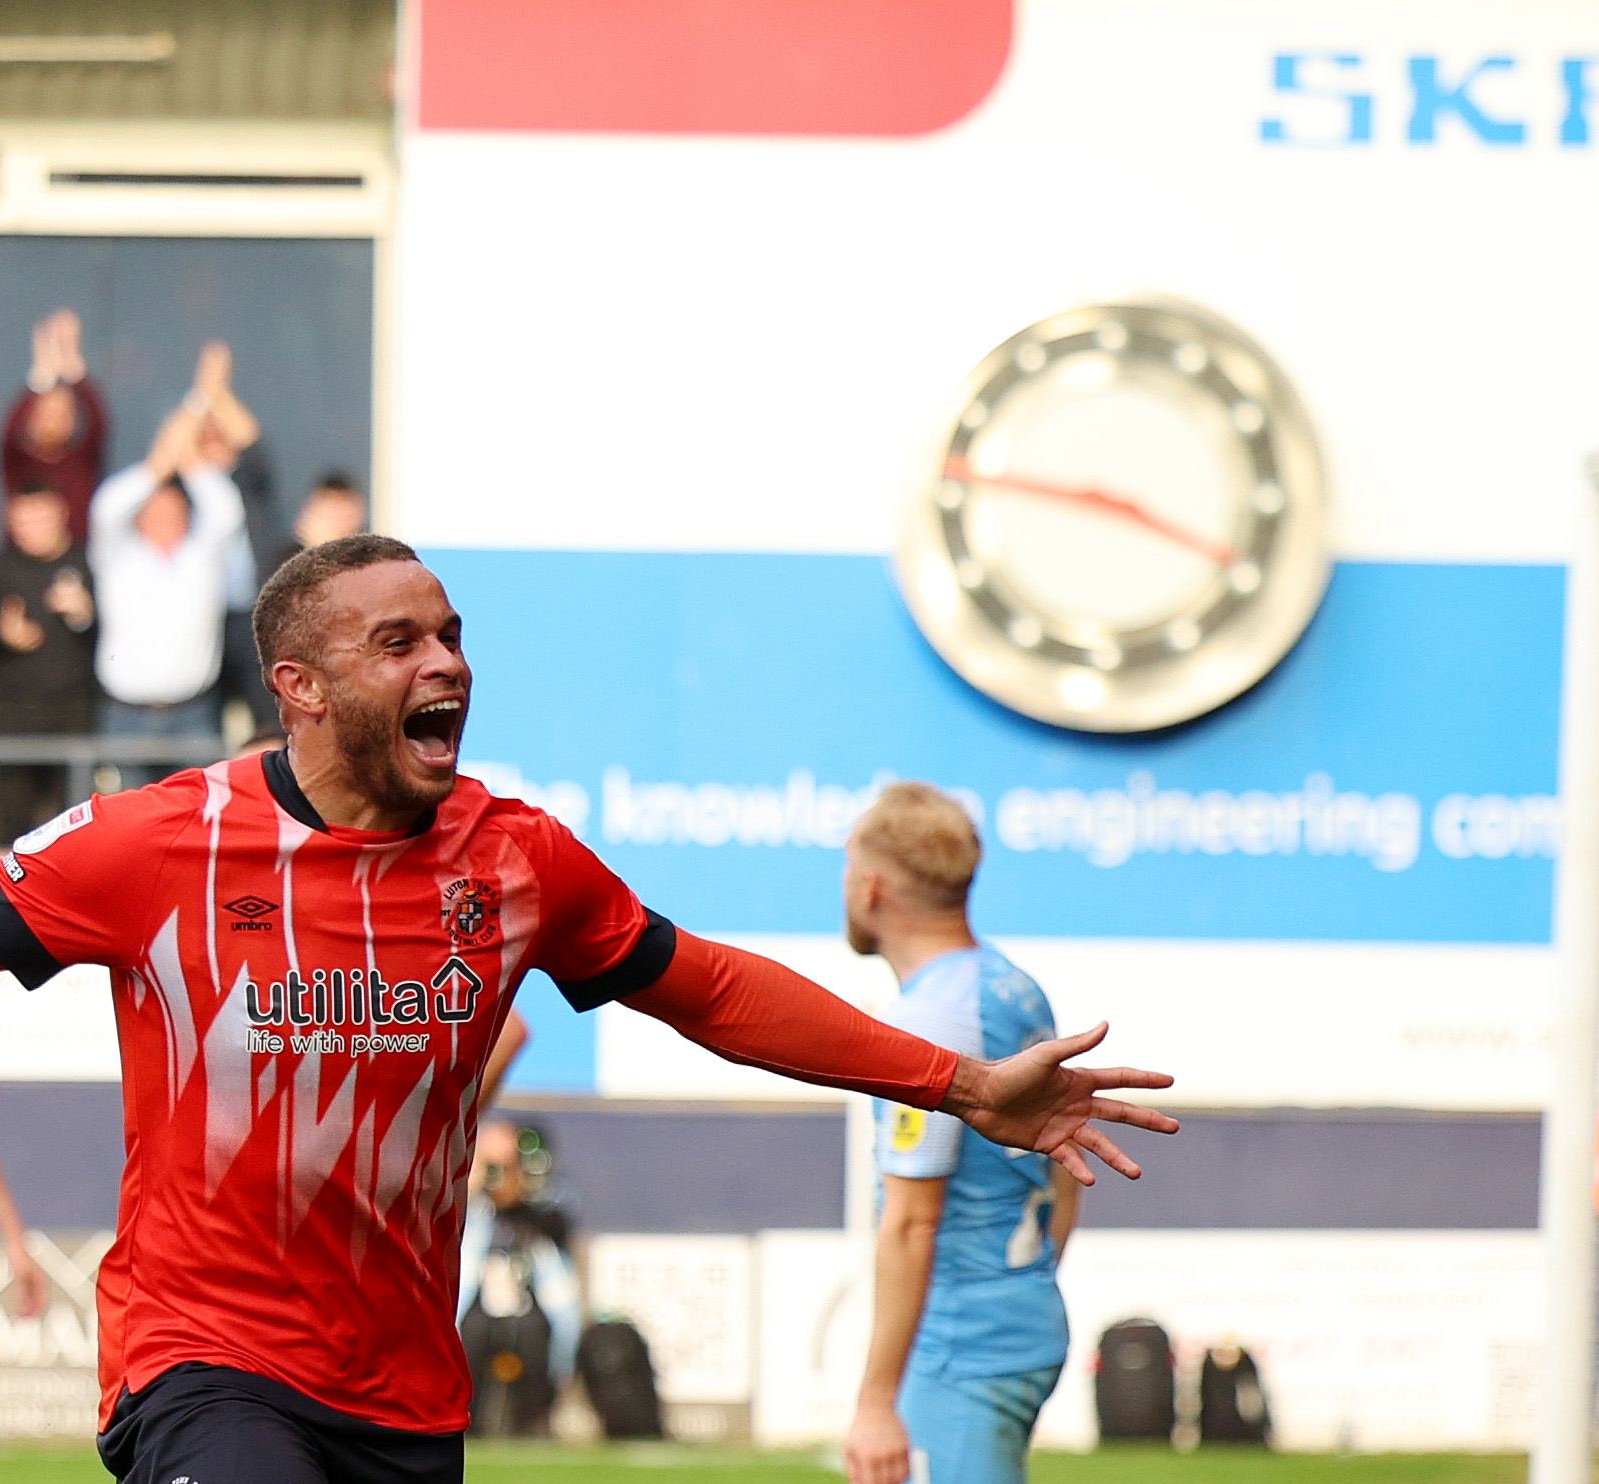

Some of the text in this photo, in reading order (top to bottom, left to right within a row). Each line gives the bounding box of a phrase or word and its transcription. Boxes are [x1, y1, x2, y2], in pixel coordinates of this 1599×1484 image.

[601, 767, 985, 848] knowle
[997, 770, 1420, 871] engineering
[443, 878, 469, 900] LUTON
[231, 920, 272, 931] umbro
[245, 968, 429, 1026] utilita
[246, 1028, 430, 1058] life with power
